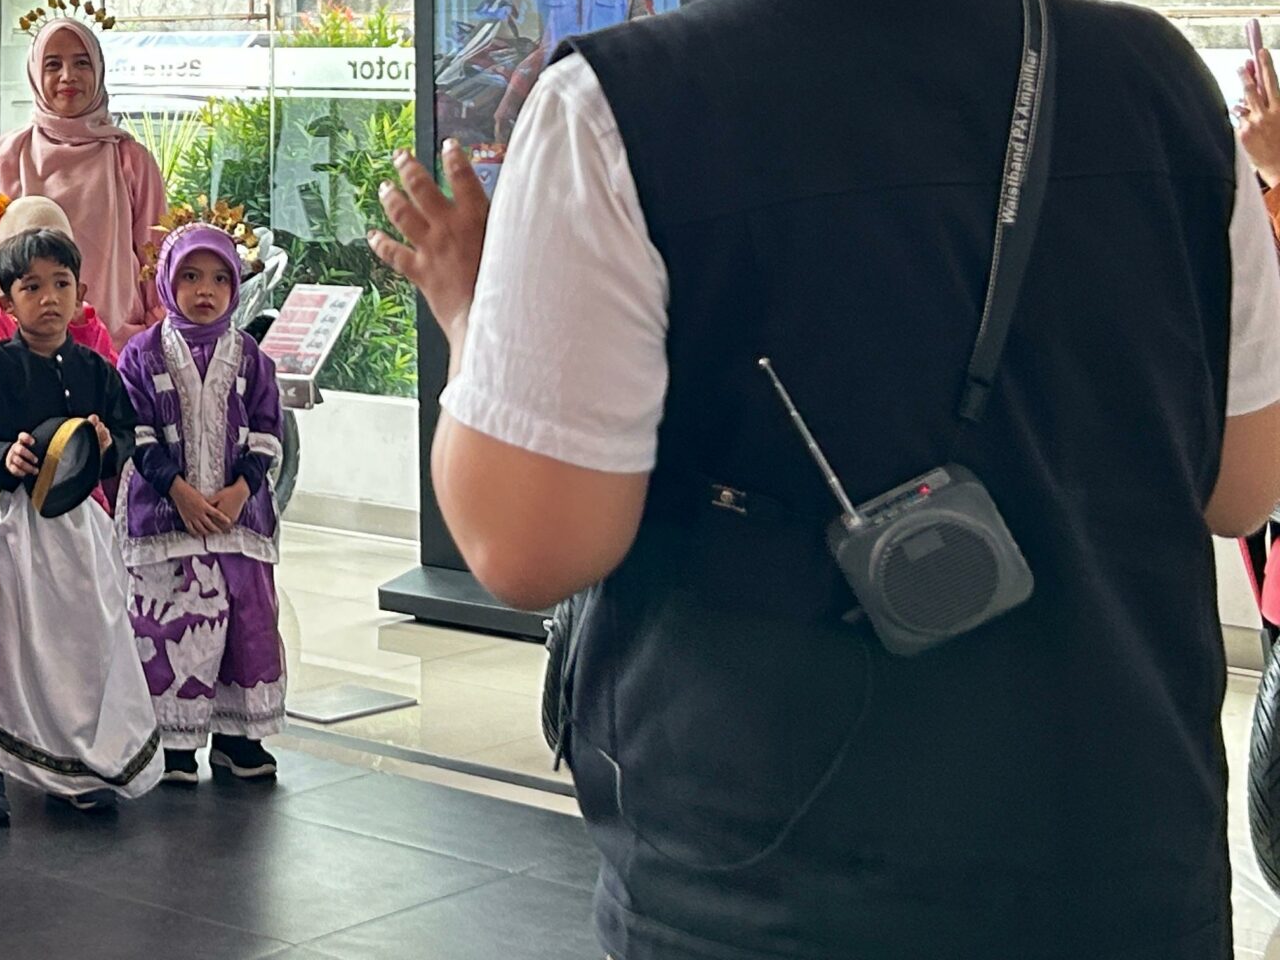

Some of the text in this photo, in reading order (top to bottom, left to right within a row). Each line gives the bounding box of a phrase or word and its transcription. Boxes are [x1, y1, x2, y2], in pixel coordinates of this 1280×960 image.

[1001, 48, 1039, 225] Waistband PA Amplifier
